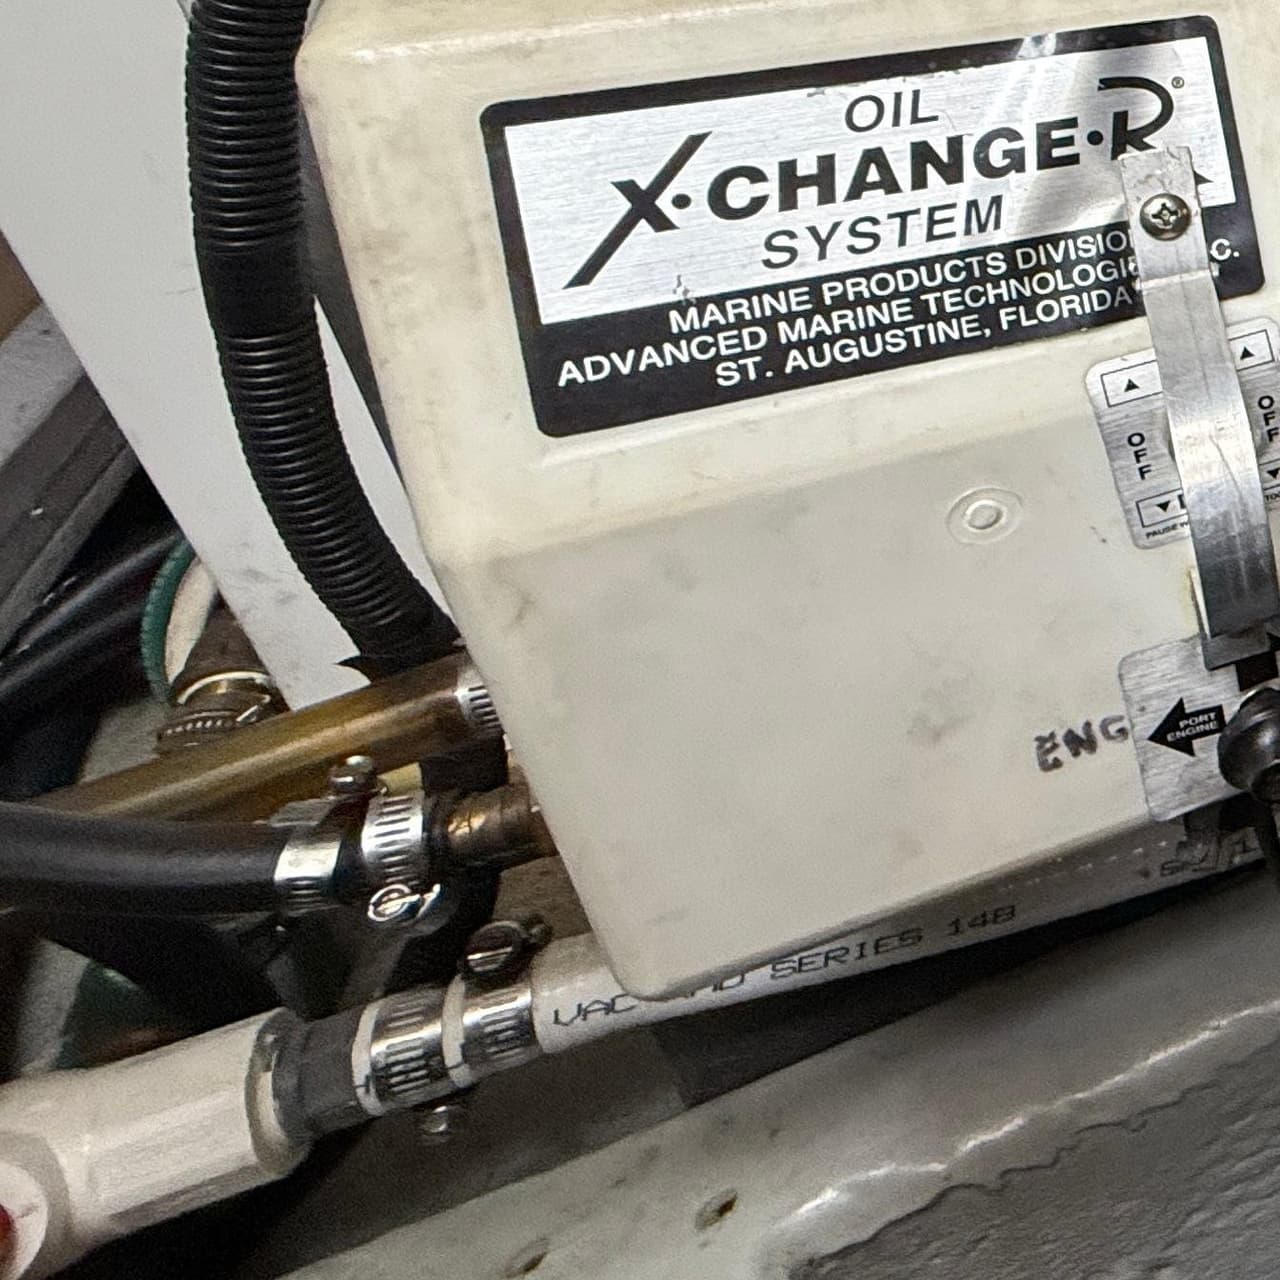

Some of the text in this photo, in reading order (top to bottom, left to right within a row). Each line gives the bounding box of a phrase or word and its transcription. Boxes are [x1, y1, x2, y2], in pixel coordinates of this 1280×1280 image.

[844, 88, 940, 134] OIL
[761, 194, 1004, 269] SYSTEM
[669, 286, 813, 334] MARINE
[822, 252, 1008, 306] PRODUCTS
[557, 325, 768, 387] ADVANCED
[778, 297, 914, 346] MARINE
[920, 256, 1139, 315] TECHNOLOGI
[715, 287, 1134, 387] ST. AUGUSTINE, FLORIDA
[1257, 394, 1280, 443] OFF
[1127, 432, 1153, 481] OFF
[1033, 714, 1130, 773] ENG
[1166, 720, 1218, 742] ENGINE
[1178, 711, 1218, 729] PORT
[770, 904, 1017, 980] SERIES 148
[553, 992, 638, 1026] VAC
